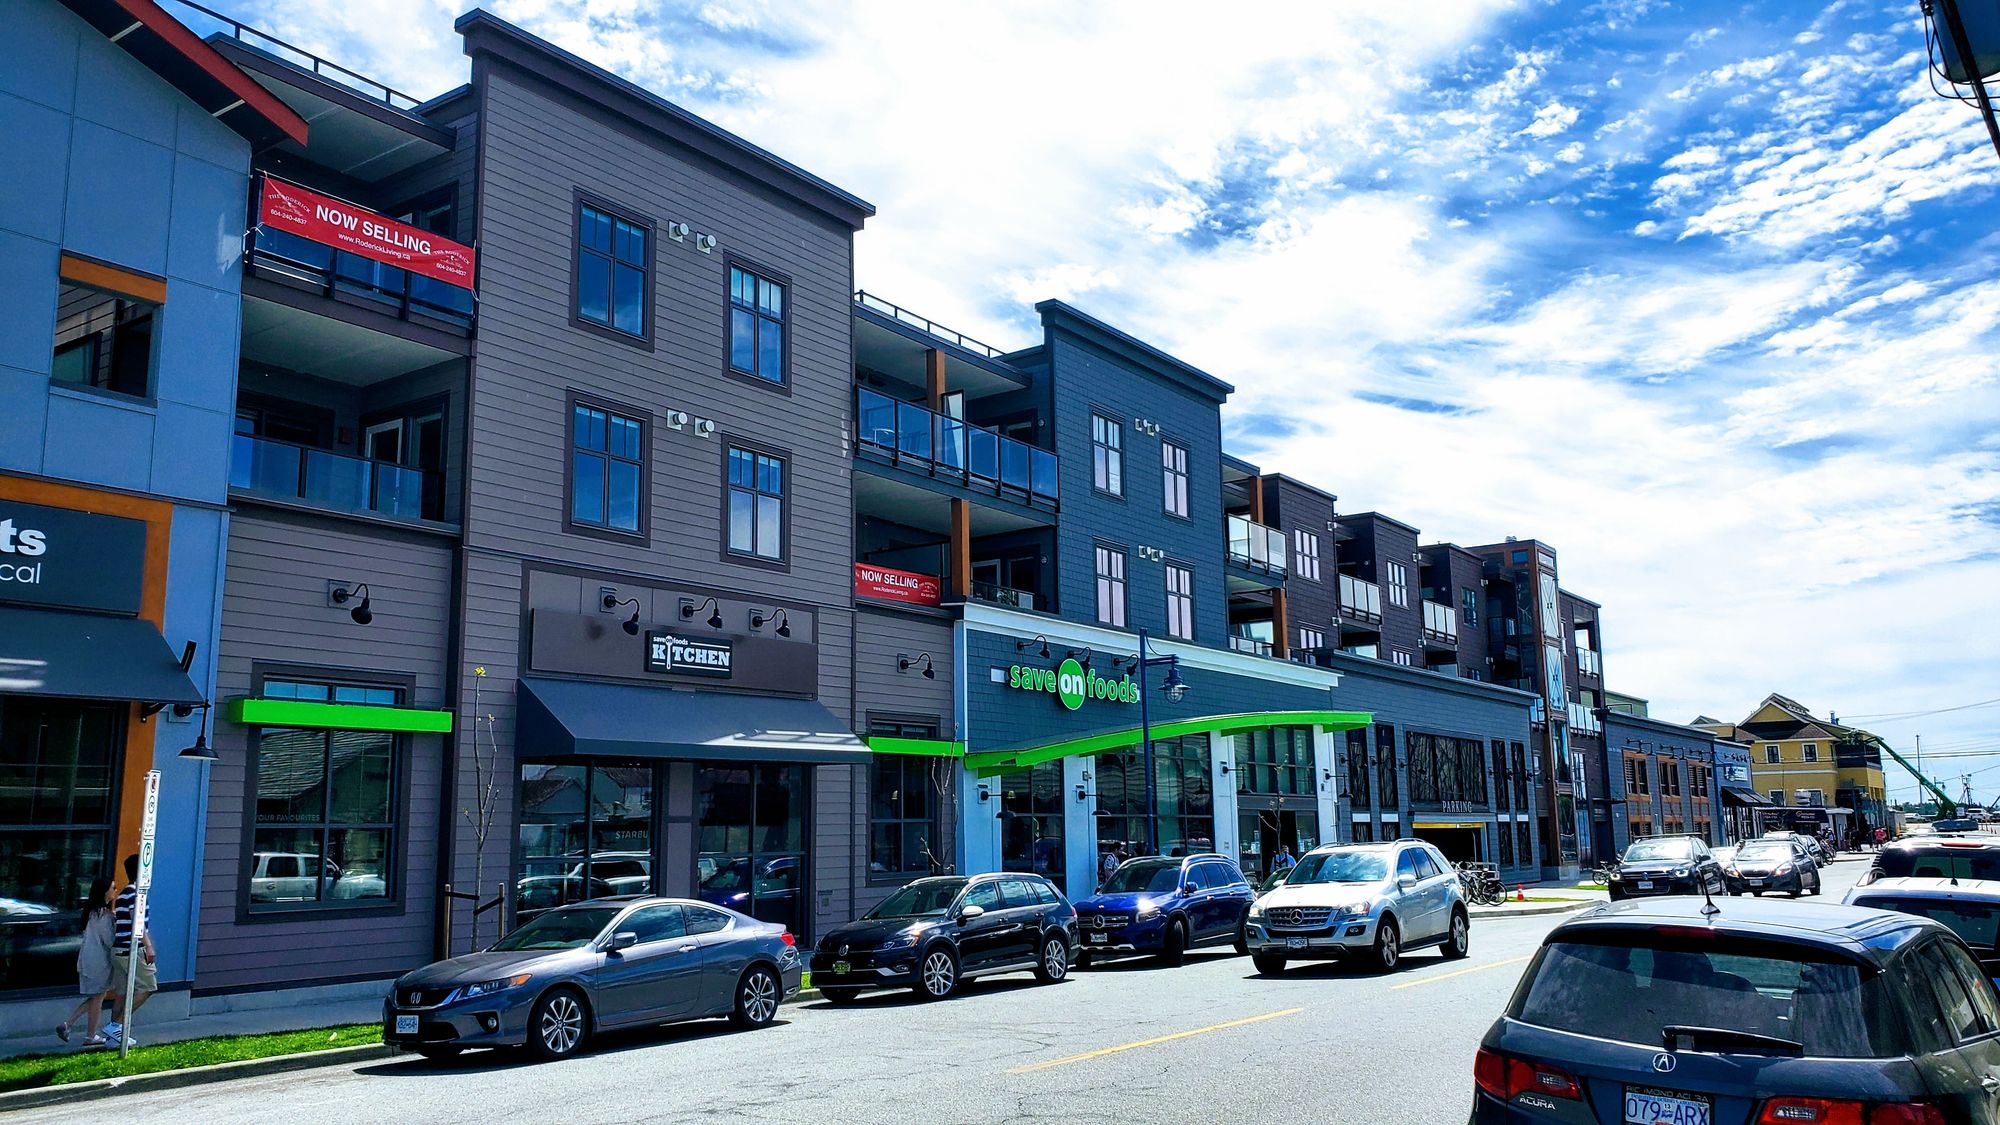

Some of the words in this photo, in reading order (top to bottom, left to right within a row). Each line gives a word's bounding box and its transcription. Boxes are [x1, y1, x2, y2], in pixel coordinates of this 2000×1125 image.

[316, 204, 358, 231] NOW
[362, 220, 431, 255] SELLING
[0, 518, 47, 556] ts
[861, 569, 882, 583] NOW
[884, 573, 918, 589] SELLING
[673, 637, 688, 645] foods
[652, 643, 730, 666] KITCHEN
[1010, 665, 1057, 693] save
[1059, 673, 1084, 696] on
[1086, 668, 1138, 704] foods
[1442, 800, 1473, 813] PARKING
[276, 813, 321, 822] FAVOURITES
[1519, 1094, 1556, 1110] ACURA
[1626, 1098, 1661, 1121] 079
[1673, 1104, 1709, 1125] ARX
